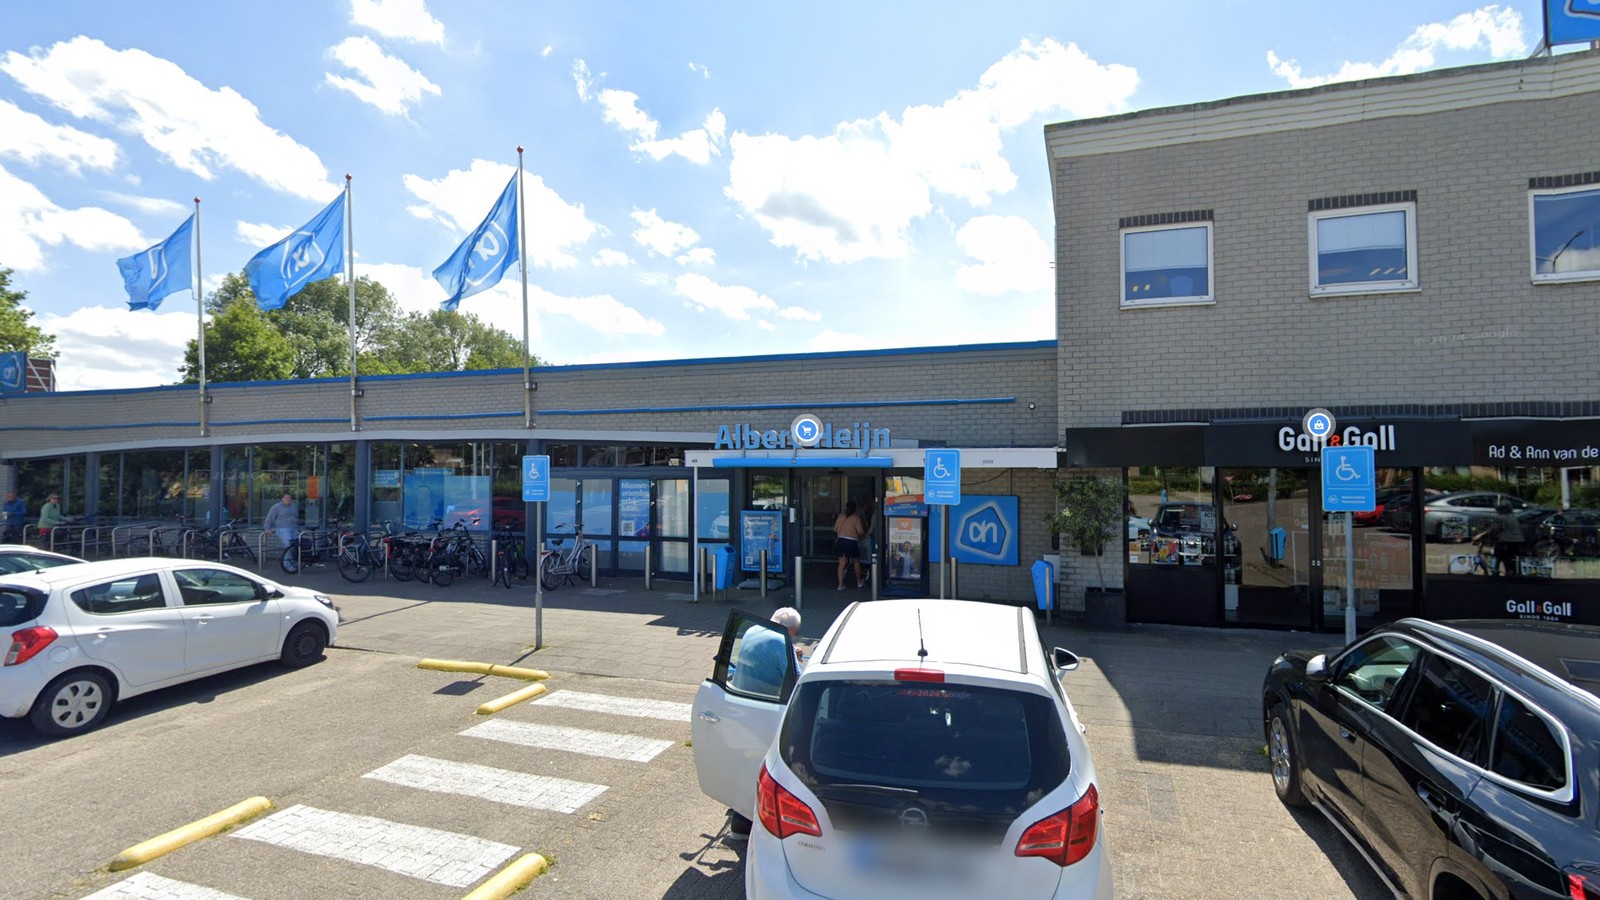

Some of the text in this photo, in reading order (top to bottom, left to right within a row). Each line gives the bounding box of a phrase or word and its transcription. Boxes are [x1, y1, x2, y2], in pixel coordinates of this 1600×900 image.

[1488, 444, 1599, 461] Ad & Ann van de
